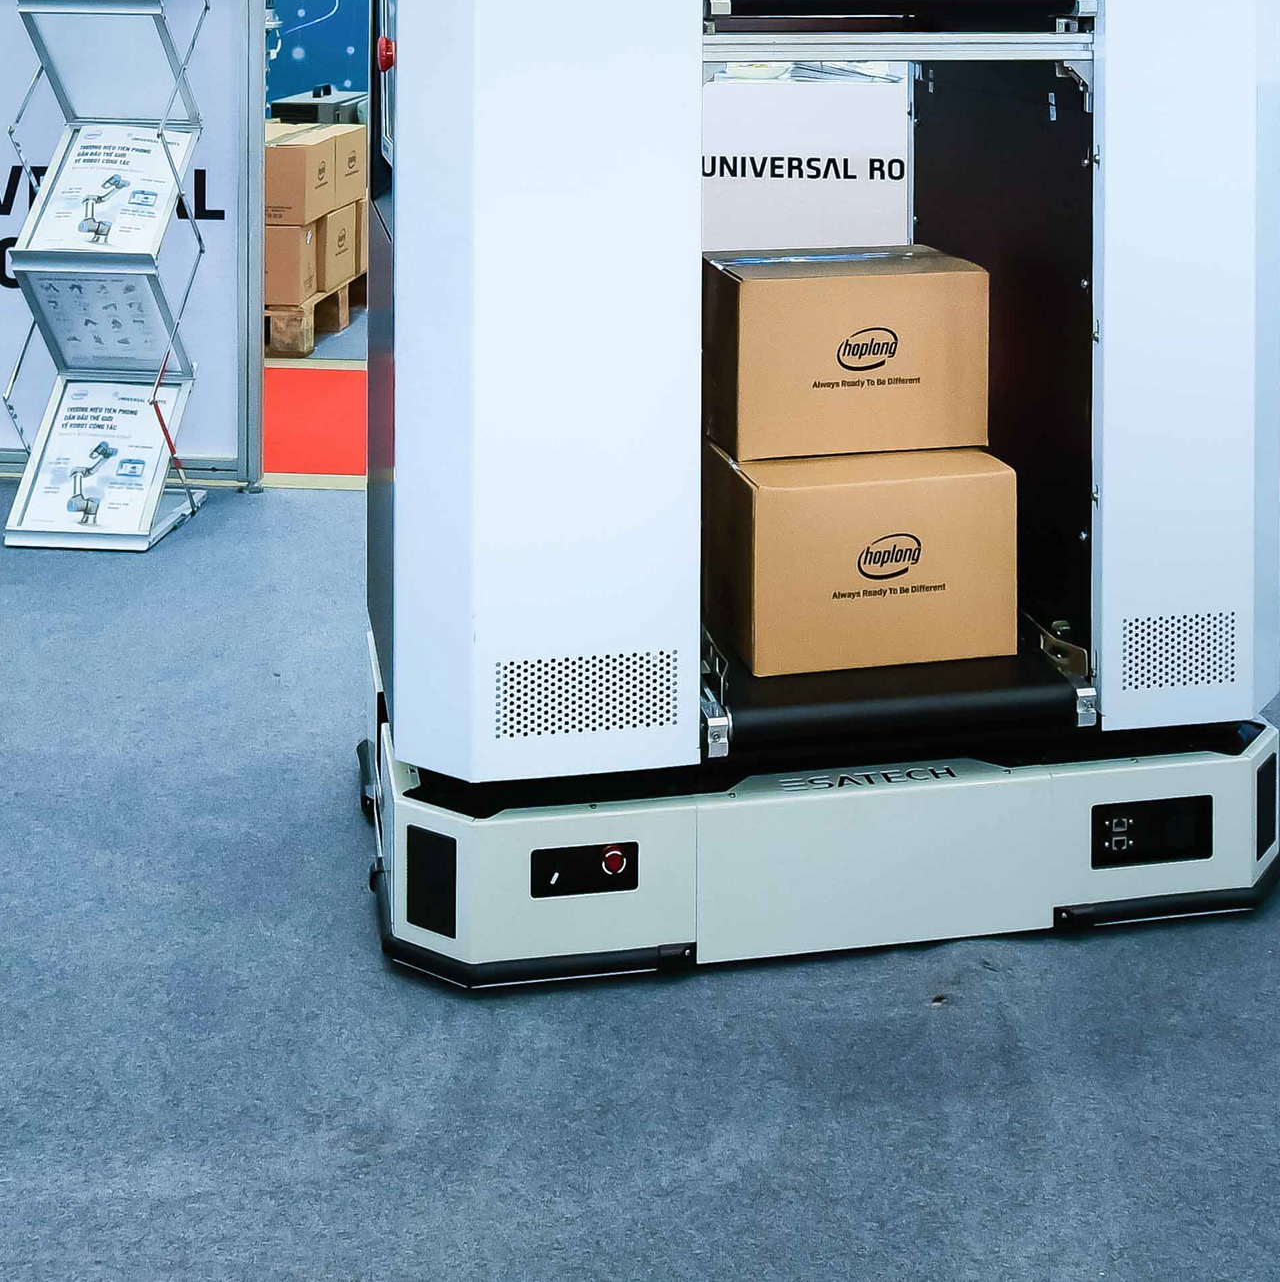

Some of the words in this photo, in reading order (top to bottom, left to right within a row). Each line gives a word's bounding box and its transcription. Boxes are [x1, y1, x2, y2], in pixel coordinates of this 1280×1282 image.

[702, 156, 857, 179] UNIVERSAL
[869, 158, 906, 180] RO
[812, 380, 840, 389] Always
[841, 379, 865, 388] Ready
[866, 378, 875, 387] To
[876, 378, 886, 386] Be
[887, 377, 921, 385] Different
[832, 591, 860, 600] Always
[862, 589, 887, 597] Ready
[889, 587, 898, 595] To
[899, 586, 909, 594] Be
[911, 583, 946, 593] Different
